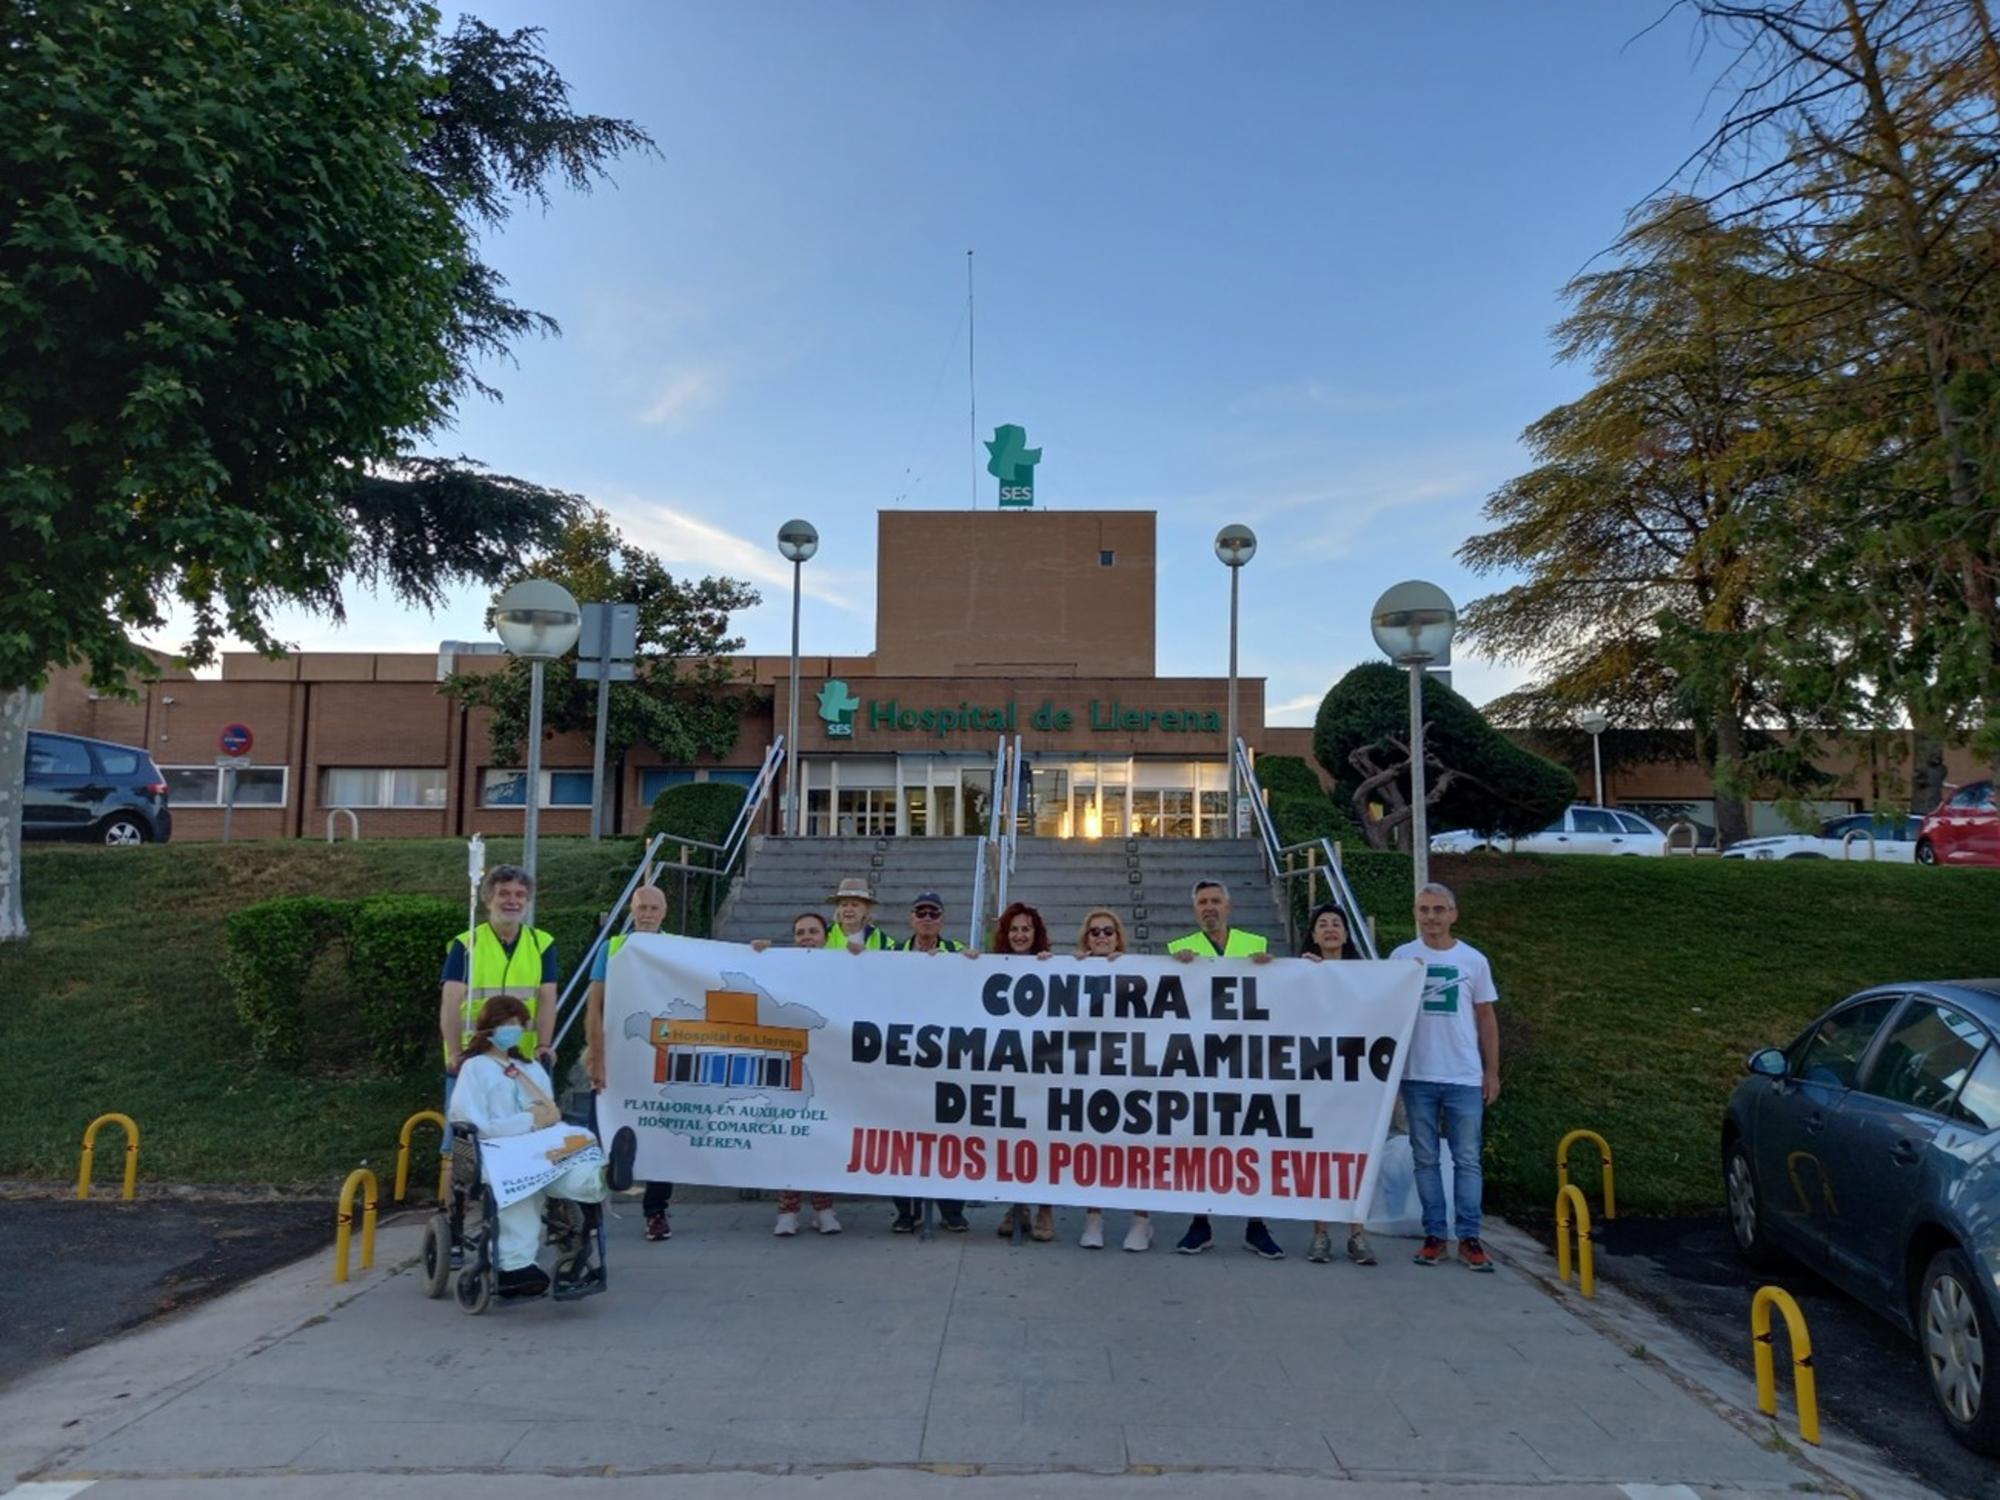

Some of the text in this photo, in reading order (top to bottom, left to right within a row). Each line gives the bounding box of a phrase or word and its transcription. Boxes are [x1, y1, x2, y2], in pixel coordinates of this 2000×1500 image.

[1001, 486, 1032, 500] SES
[869, 698, 1222, 737] Hospital de Llerena
[828, 723, 852, 736] SES
[982, 973, 1270, 1021] CONTRA EL
[673, 1029, 729, 1044] Hospital
[734, 1032, 751, 1044] de
[852, 1021, 1397, 1083] DESMANTELAMIENTO
[624, 1099, 829, 1121] PLATAFORMA EN AUXILIO DEL
[935, 1081, 1314, 1139] DEL HOSPITAL
[638, 1116, 811, 1137] HOSPITAL COMARCAL DE
[690, 1135, 753, 1151] LLERENA
[847, 1127, 987, 1181] JUNTOS
[997, 1139, 1038, 1183] LO
[1048, 1142, 1261, 1197] PODREMOS
